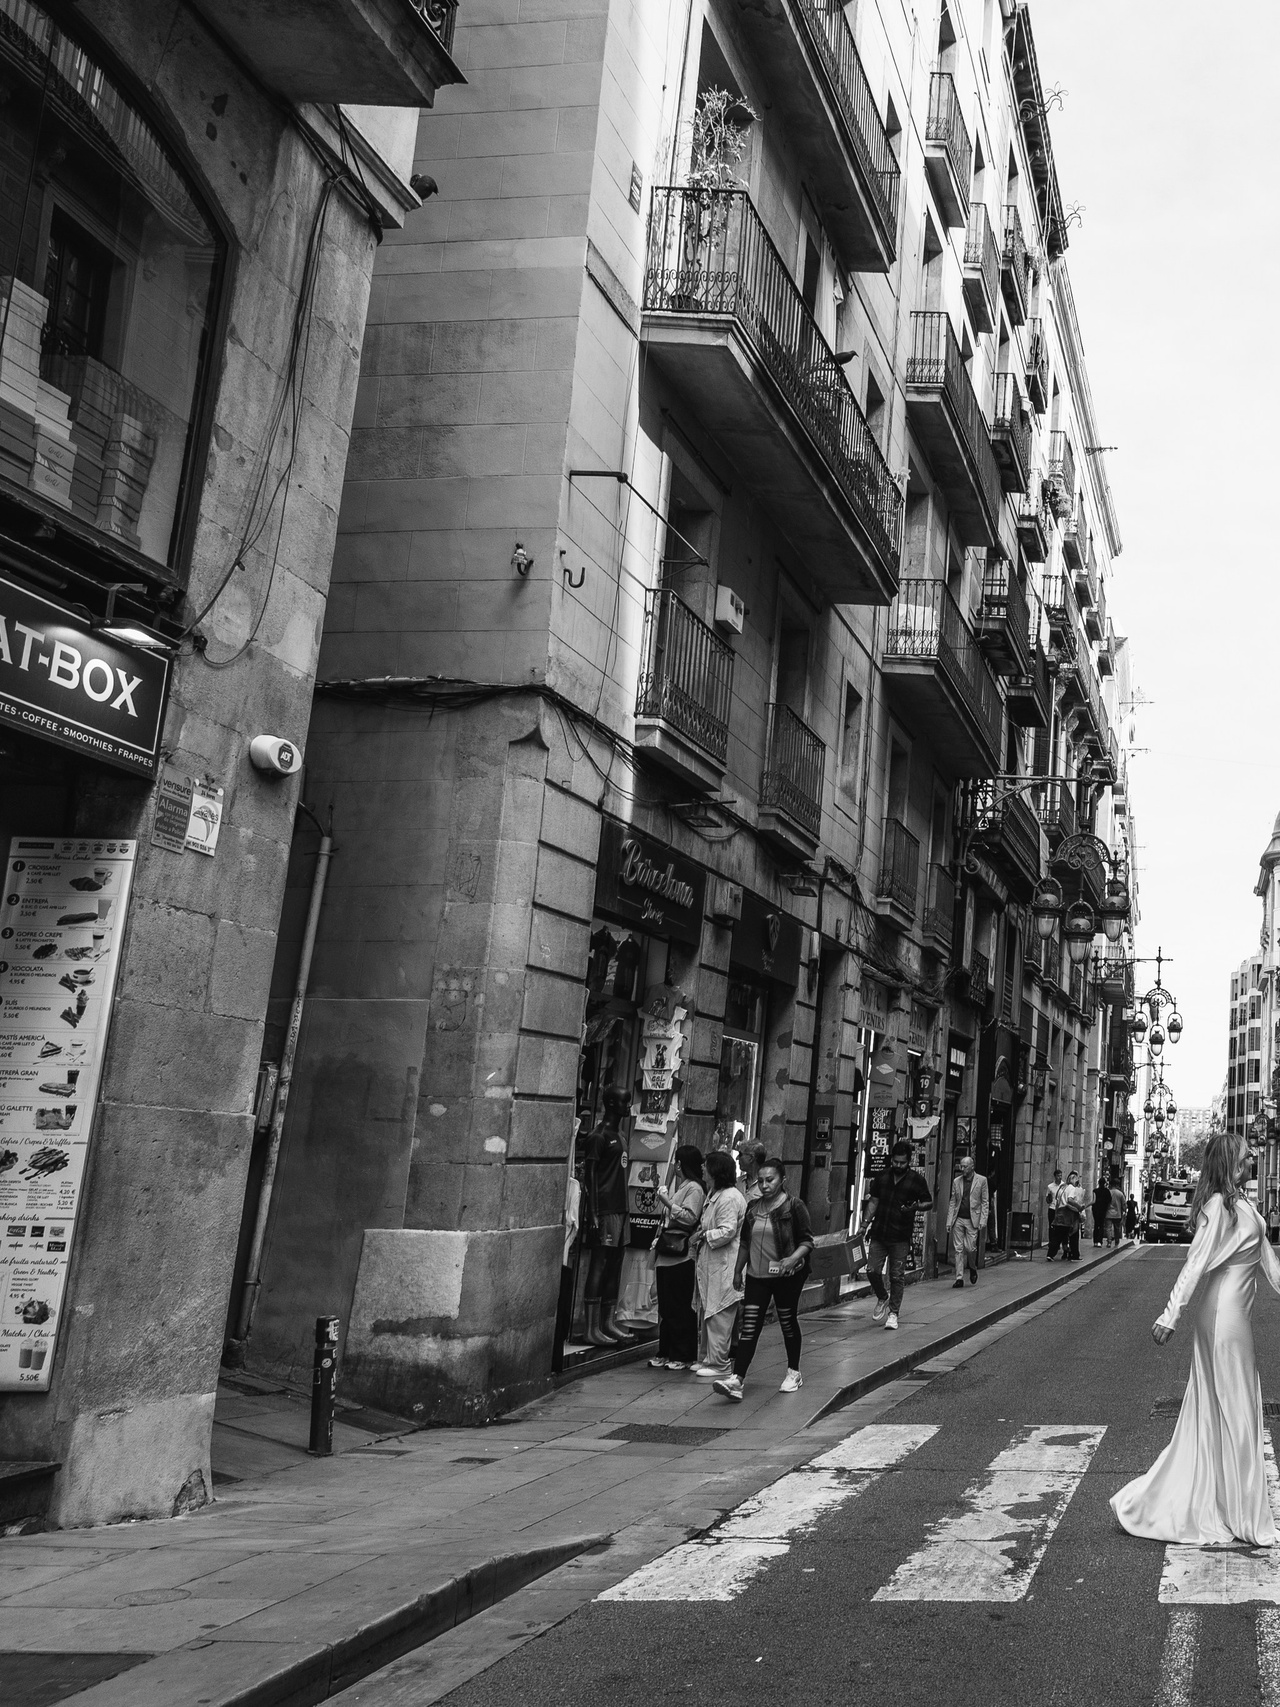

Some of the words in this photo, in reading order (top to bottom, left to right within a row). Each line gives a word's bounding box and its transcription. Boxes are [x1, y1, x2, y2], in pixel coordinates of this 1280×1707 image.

[22, 711, 59, 731] COFFEE
[64, 731, 114, 753] SMOOTHIES
[118, 747, 154, 768] FRAPPES
[280, 751, 292, 763] ADT
[160, 798, 189, 817] Alarma
[920, 1078, 930, 1089] 19
[920, 1103, 926, 1114] 9
[18, 1213, 40, 1221] drinks
[0, 1329, 27, 1337] Matcha
[34, 1329, 50, 1338] Chai
